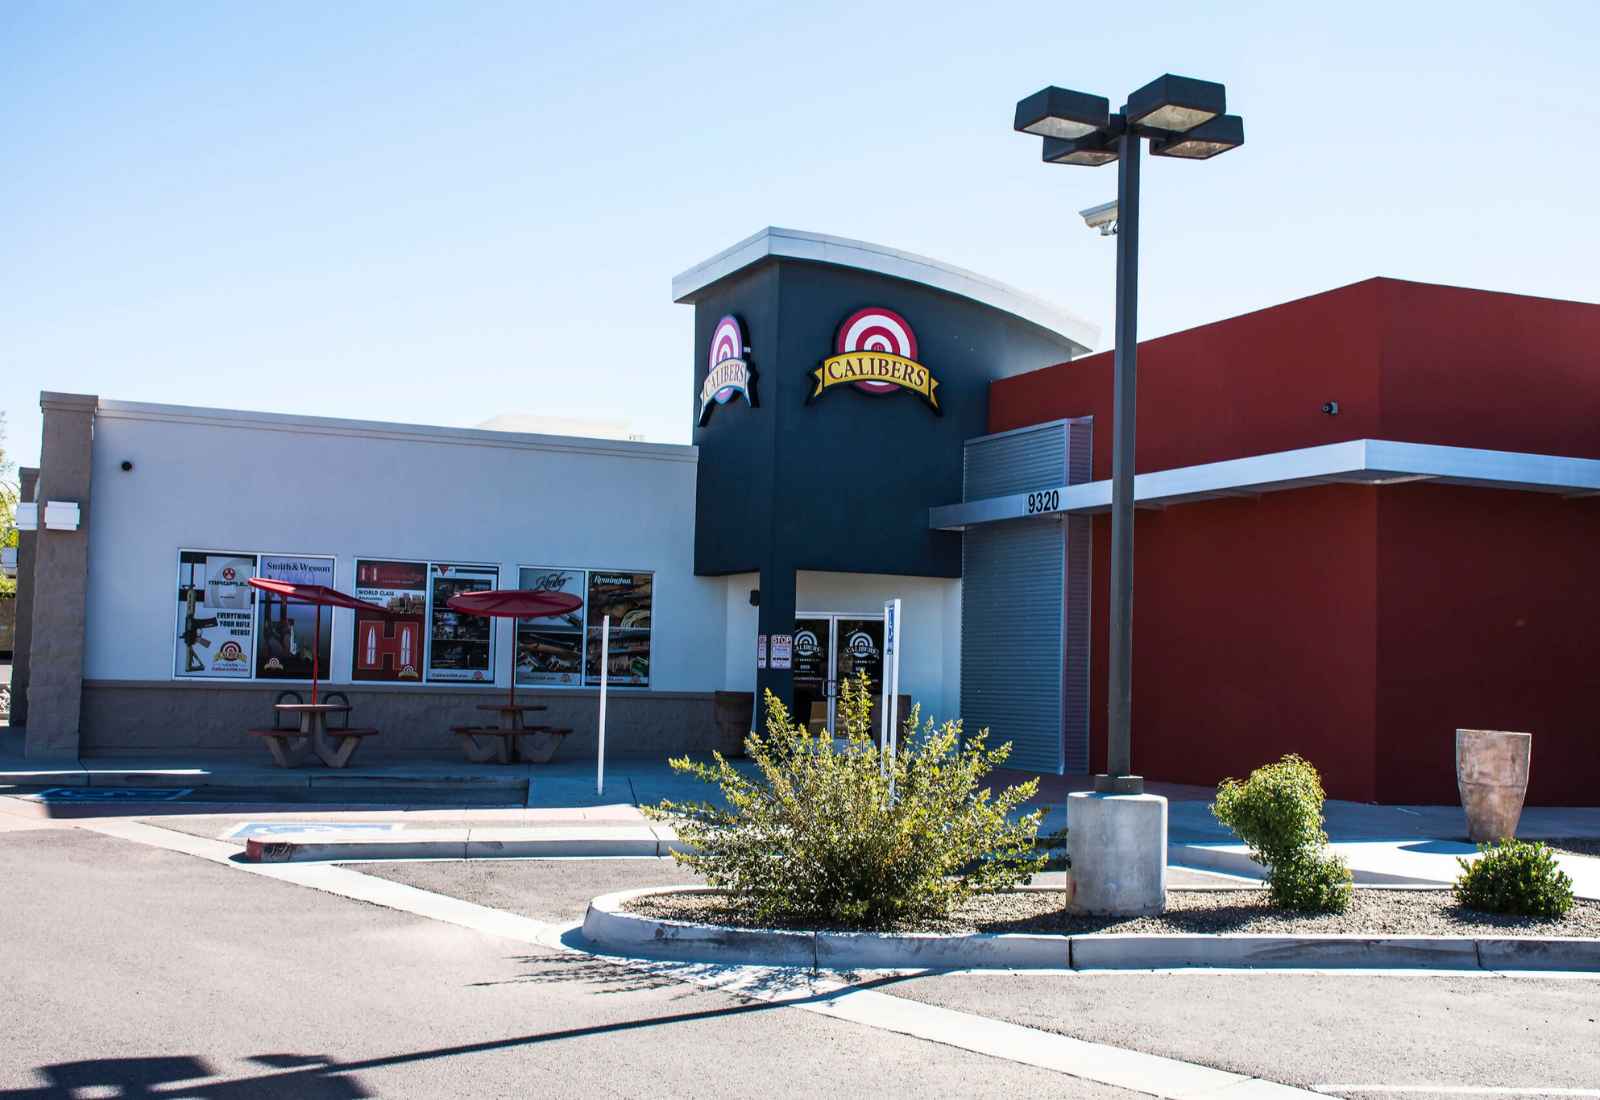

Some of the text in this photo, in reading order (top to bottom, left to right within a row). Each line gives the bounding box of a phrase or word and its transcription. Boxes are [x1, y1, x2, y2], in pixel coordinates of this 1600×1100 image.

[705, 363, 744, 398] CALIBERS
[828, 357, 926, 387] CALIBERS
[1028, 490, 1060, 514] 9320
[593, 575, 632, 585] Remington
[216, 612, 251, 620] EVERYTHING
[219, 620, 235, 628] YOUR
